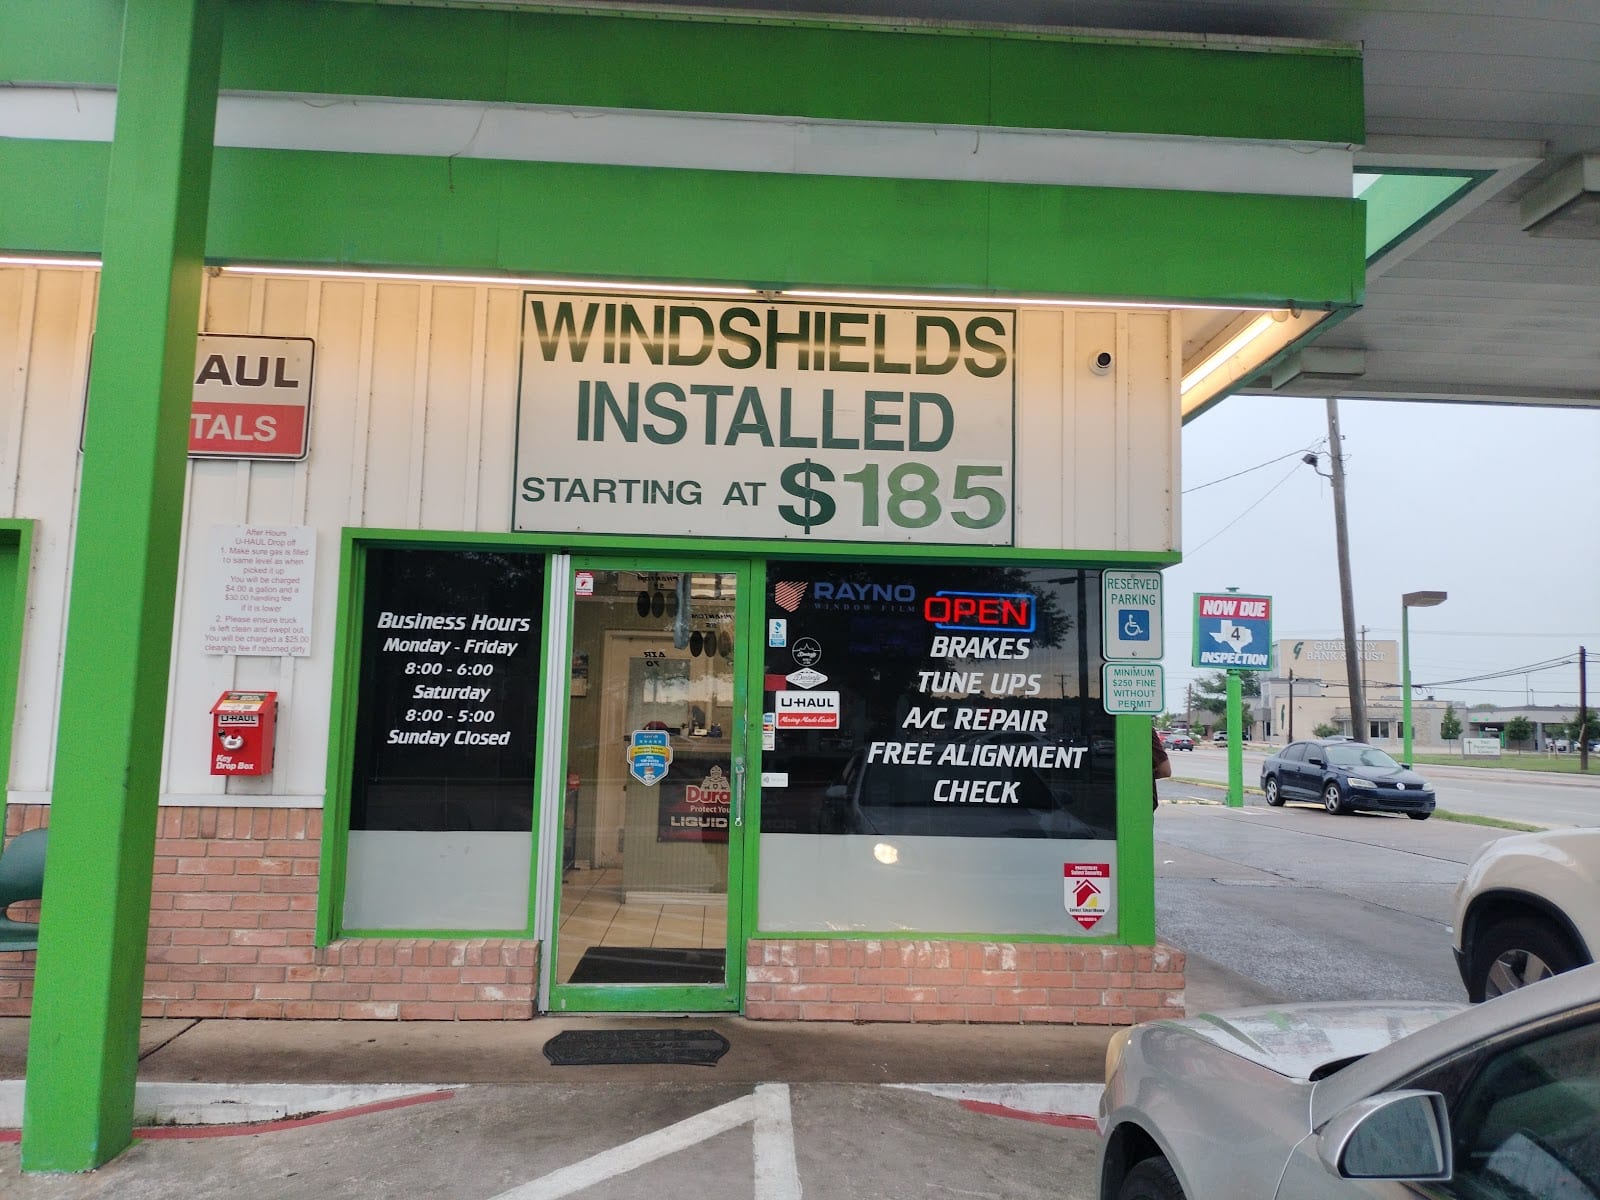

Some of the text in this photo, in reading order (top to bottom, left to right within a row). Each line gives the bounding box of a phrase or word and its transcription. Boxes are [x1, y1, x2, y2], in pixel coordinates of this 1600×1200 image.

[531, 300, 1007, 378] WINDSHIELDS
[195, 354, 299, 388] AUL
[577, 380, 954, 452] INSTALLED
[191, 413, 277, 442] TALS
[522, 458, 1007, 534] STARTING AT $185
[267, 539, 285, 547] Drop
[269, 549, 283, 557] gas
[230, 575, 245, 583] You
[271, 577, 300, 585] charged
[1107, 577, 1159, 590] RESERVED
[255, 586, 277, 594] gallon
[814, 582, 916, 602] RAYNO
[251, 594, 279, 602] handling
[1111, 593, 1156, 606] PARKING
[814, 602, 916, 613] WINDOW FILM
[924, 597, 1028, 626] OPEN
[1202, 599, 1266, 618] NOW DUE
[225, 615, 251, 623] Please
[377, 611, 531, 631] Business Hours
[231, 625, 252, 633] clean
[1230, 627, 1241, 641] 4
[235, 634, 245, 642] be
[246, 635, 276, 643] charged
[258, 645, 289, 653] returned
[383, 637, 451, 655] Monday
[463, 639, 519, 656] Friday
[930, 635, 1031, 660] BRAKES
[1200, 651, 1269, 666] INSPECTION
[1306, 651, 1338, 660] BANK
[404, 662, 443, 675] 8:00
[456, 663, 494, 676] 6:00
[1113, 668, 1155, 677] MINIMUM
[918, 671, 1042, 696] TUNE UPS
[1112, 679, 1156, 688] $250 FINE
[412, 684, 491, 702] Saturday
[1113, 689, 1155, 698] WITHOUT
[781, 698, 834, 707] U-HAUL
[1118, 700, 1153, 708] PERMIT
[405, 709, 444, 722] 8:00
[457, 710, 495, 722] 5:00
[902, 706, 1049, 732] A/C REPAIR
[387, 729, 511, 747] Sunday Closed
[216, 754, 232, 763] Key
[866, 741, 1089, 769] FREE ALIGNMENT
[215, 762, 236, 770] Drop
[933, 779, 1021, 804] CHECK
[690, 805, 717, 813] Protect
[670, 816, 728, 828] LIQUID
